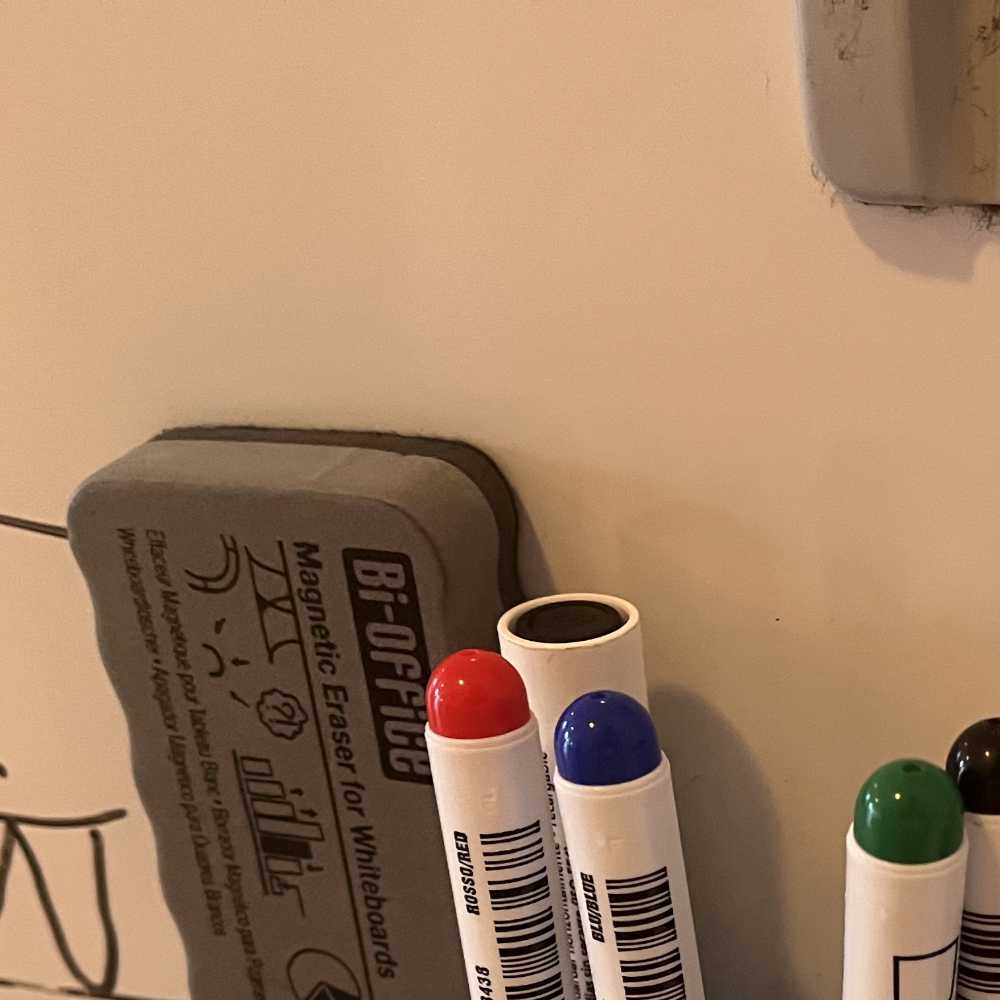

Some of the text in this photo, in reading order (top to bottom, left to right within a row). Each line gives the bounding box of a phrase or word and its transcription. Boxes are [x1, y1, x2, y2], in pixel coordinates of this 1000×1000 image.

[293, 543, 394, 978] Magnetic Eraser for Whiteboards
[453, 831, 480, 914] ROSSO/RED
[579, 871, 604, 942] BLU/BLUE
